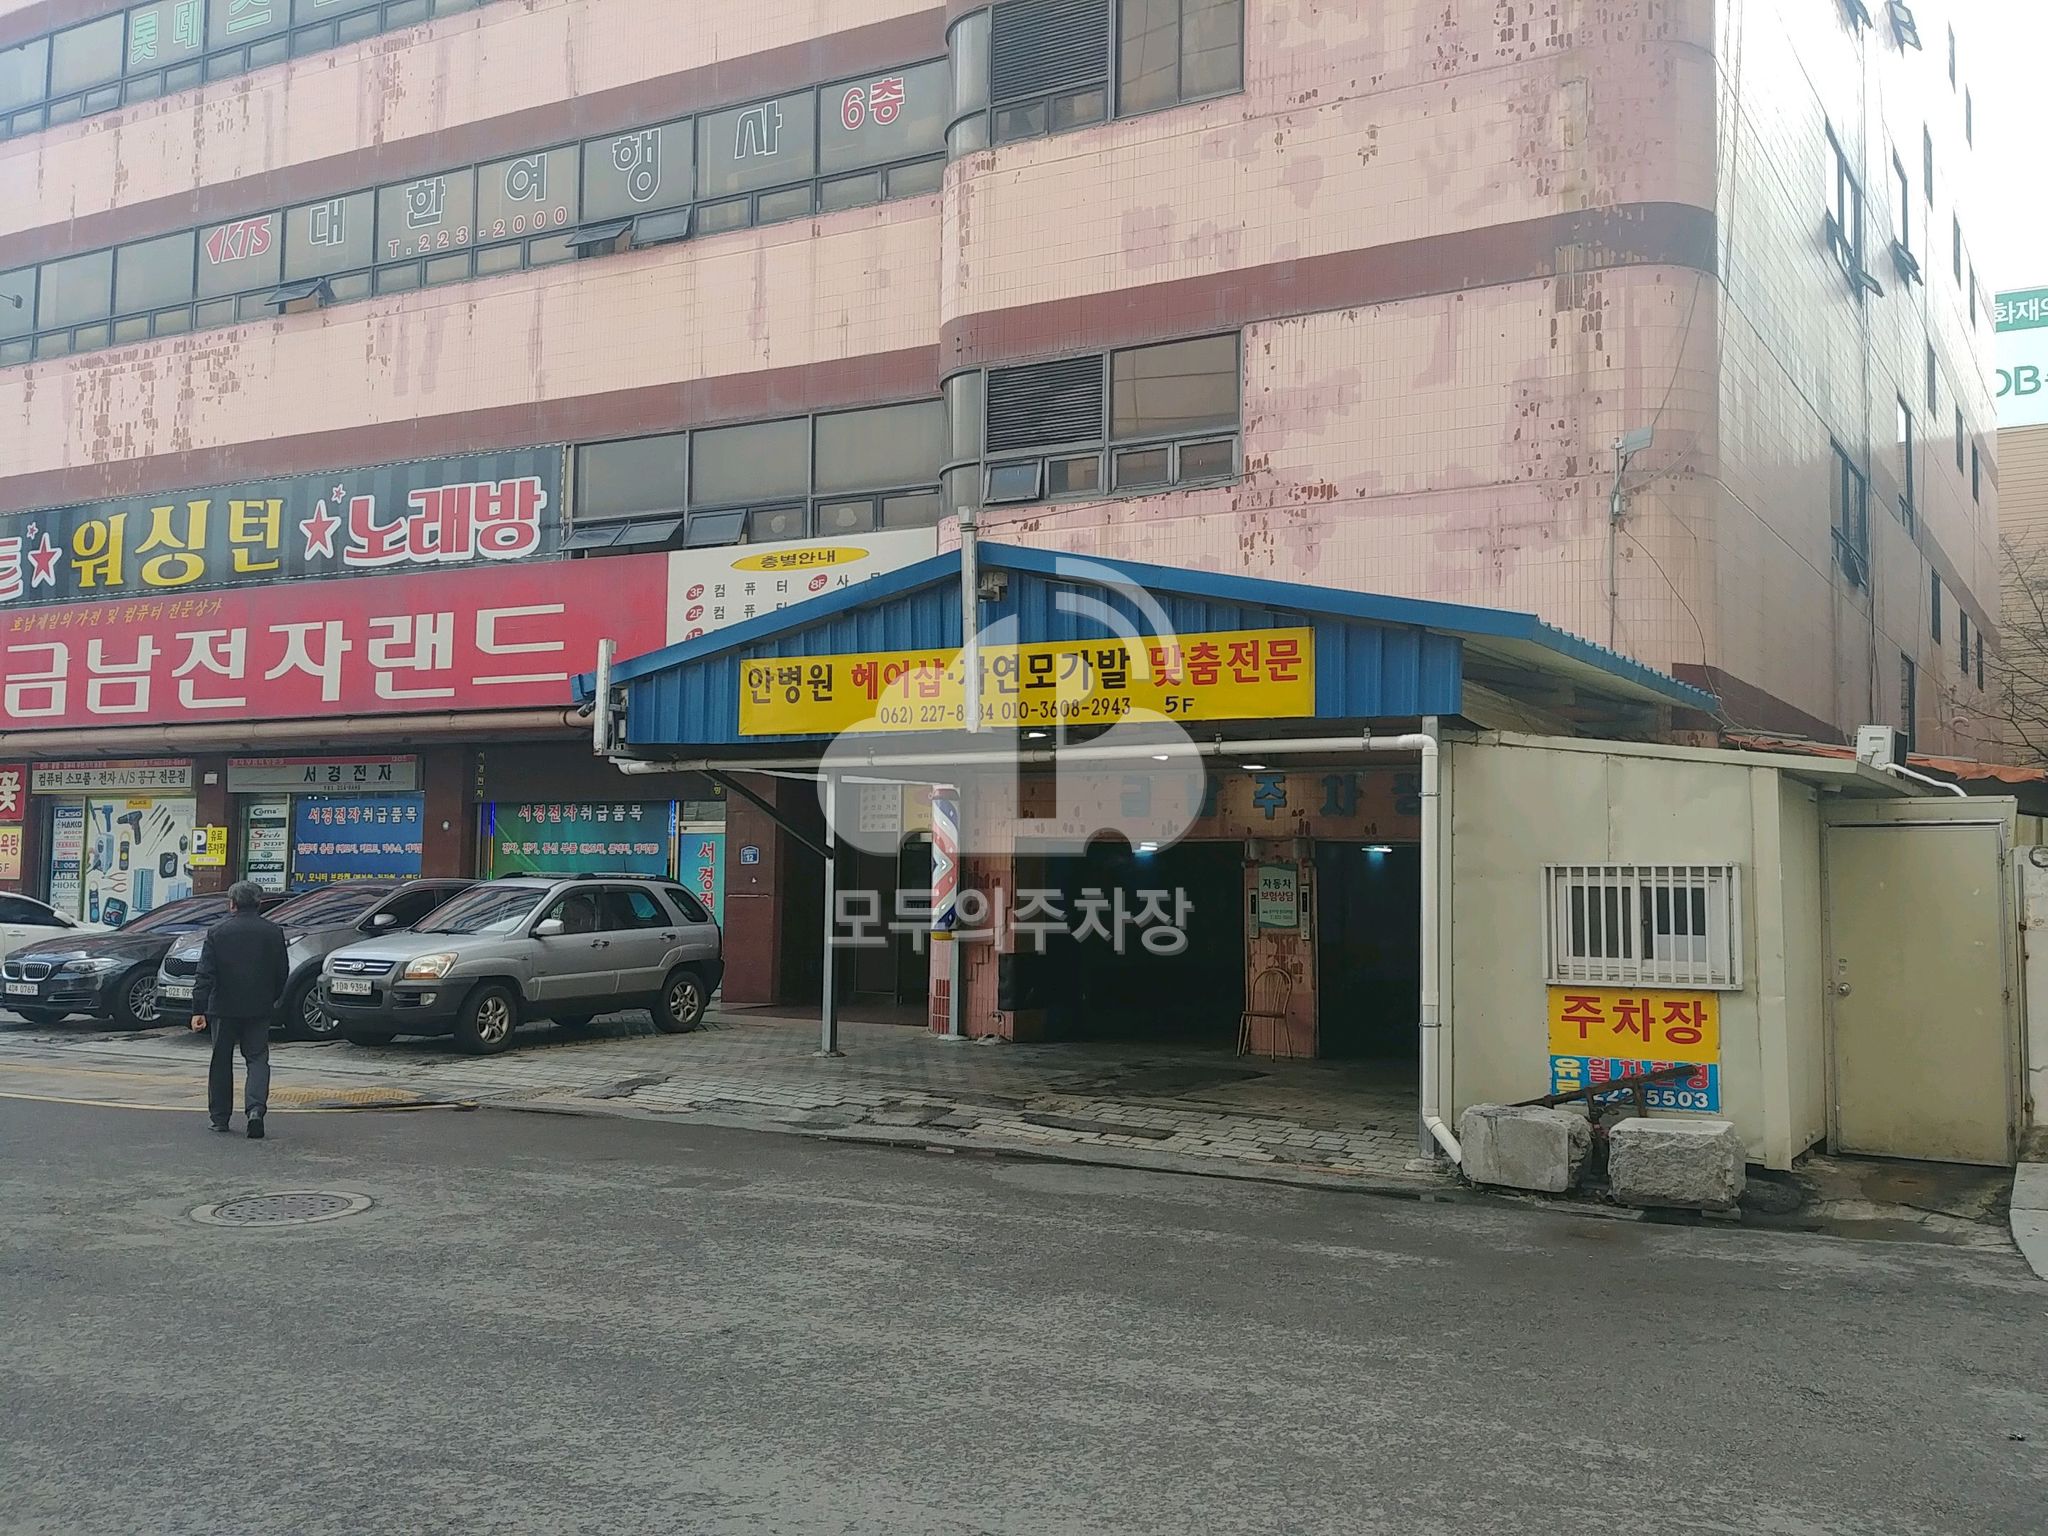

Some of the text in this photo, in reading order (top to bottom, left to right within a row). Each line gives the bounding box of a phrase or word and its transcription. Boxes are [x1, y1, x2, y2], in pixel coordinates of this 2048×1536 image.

[840, 76, 905, 131] 6층
[221, 215, 272, 263] KTS
[71, 498, 285, 589] 워싱턴
[344, 475, 548, 567] 노래방
[760, 550, 836, 570] 층별안내
[689, 578, 789, 599] 3F 컴퓨터
[811, 578, 825, 590] 8F
[689, 607, 703, 619] 2F
[4, 603, 568, 718] 금남전자랜드
[747, 664, 834, 704] 안병원
[1148, 639, 1302, 688] 맞춤전문
[1001, 697, 1132, 720] 010-3608-2943
[1164, 695, 1195, 713] 5F
[38, 771, 63, 787] 컴퓨터
[118, 771, 136, 785] A/S
[138, 770, 156, 785] 공구
[159, 768, 186, 785] 전문점
[303, 764, 392, 783] 서경전자
[211, 830, 224, 842] 유료
[1262, 878, 1292, 890] 자동차
[1561, 995, 1708, 1045] 주차장
